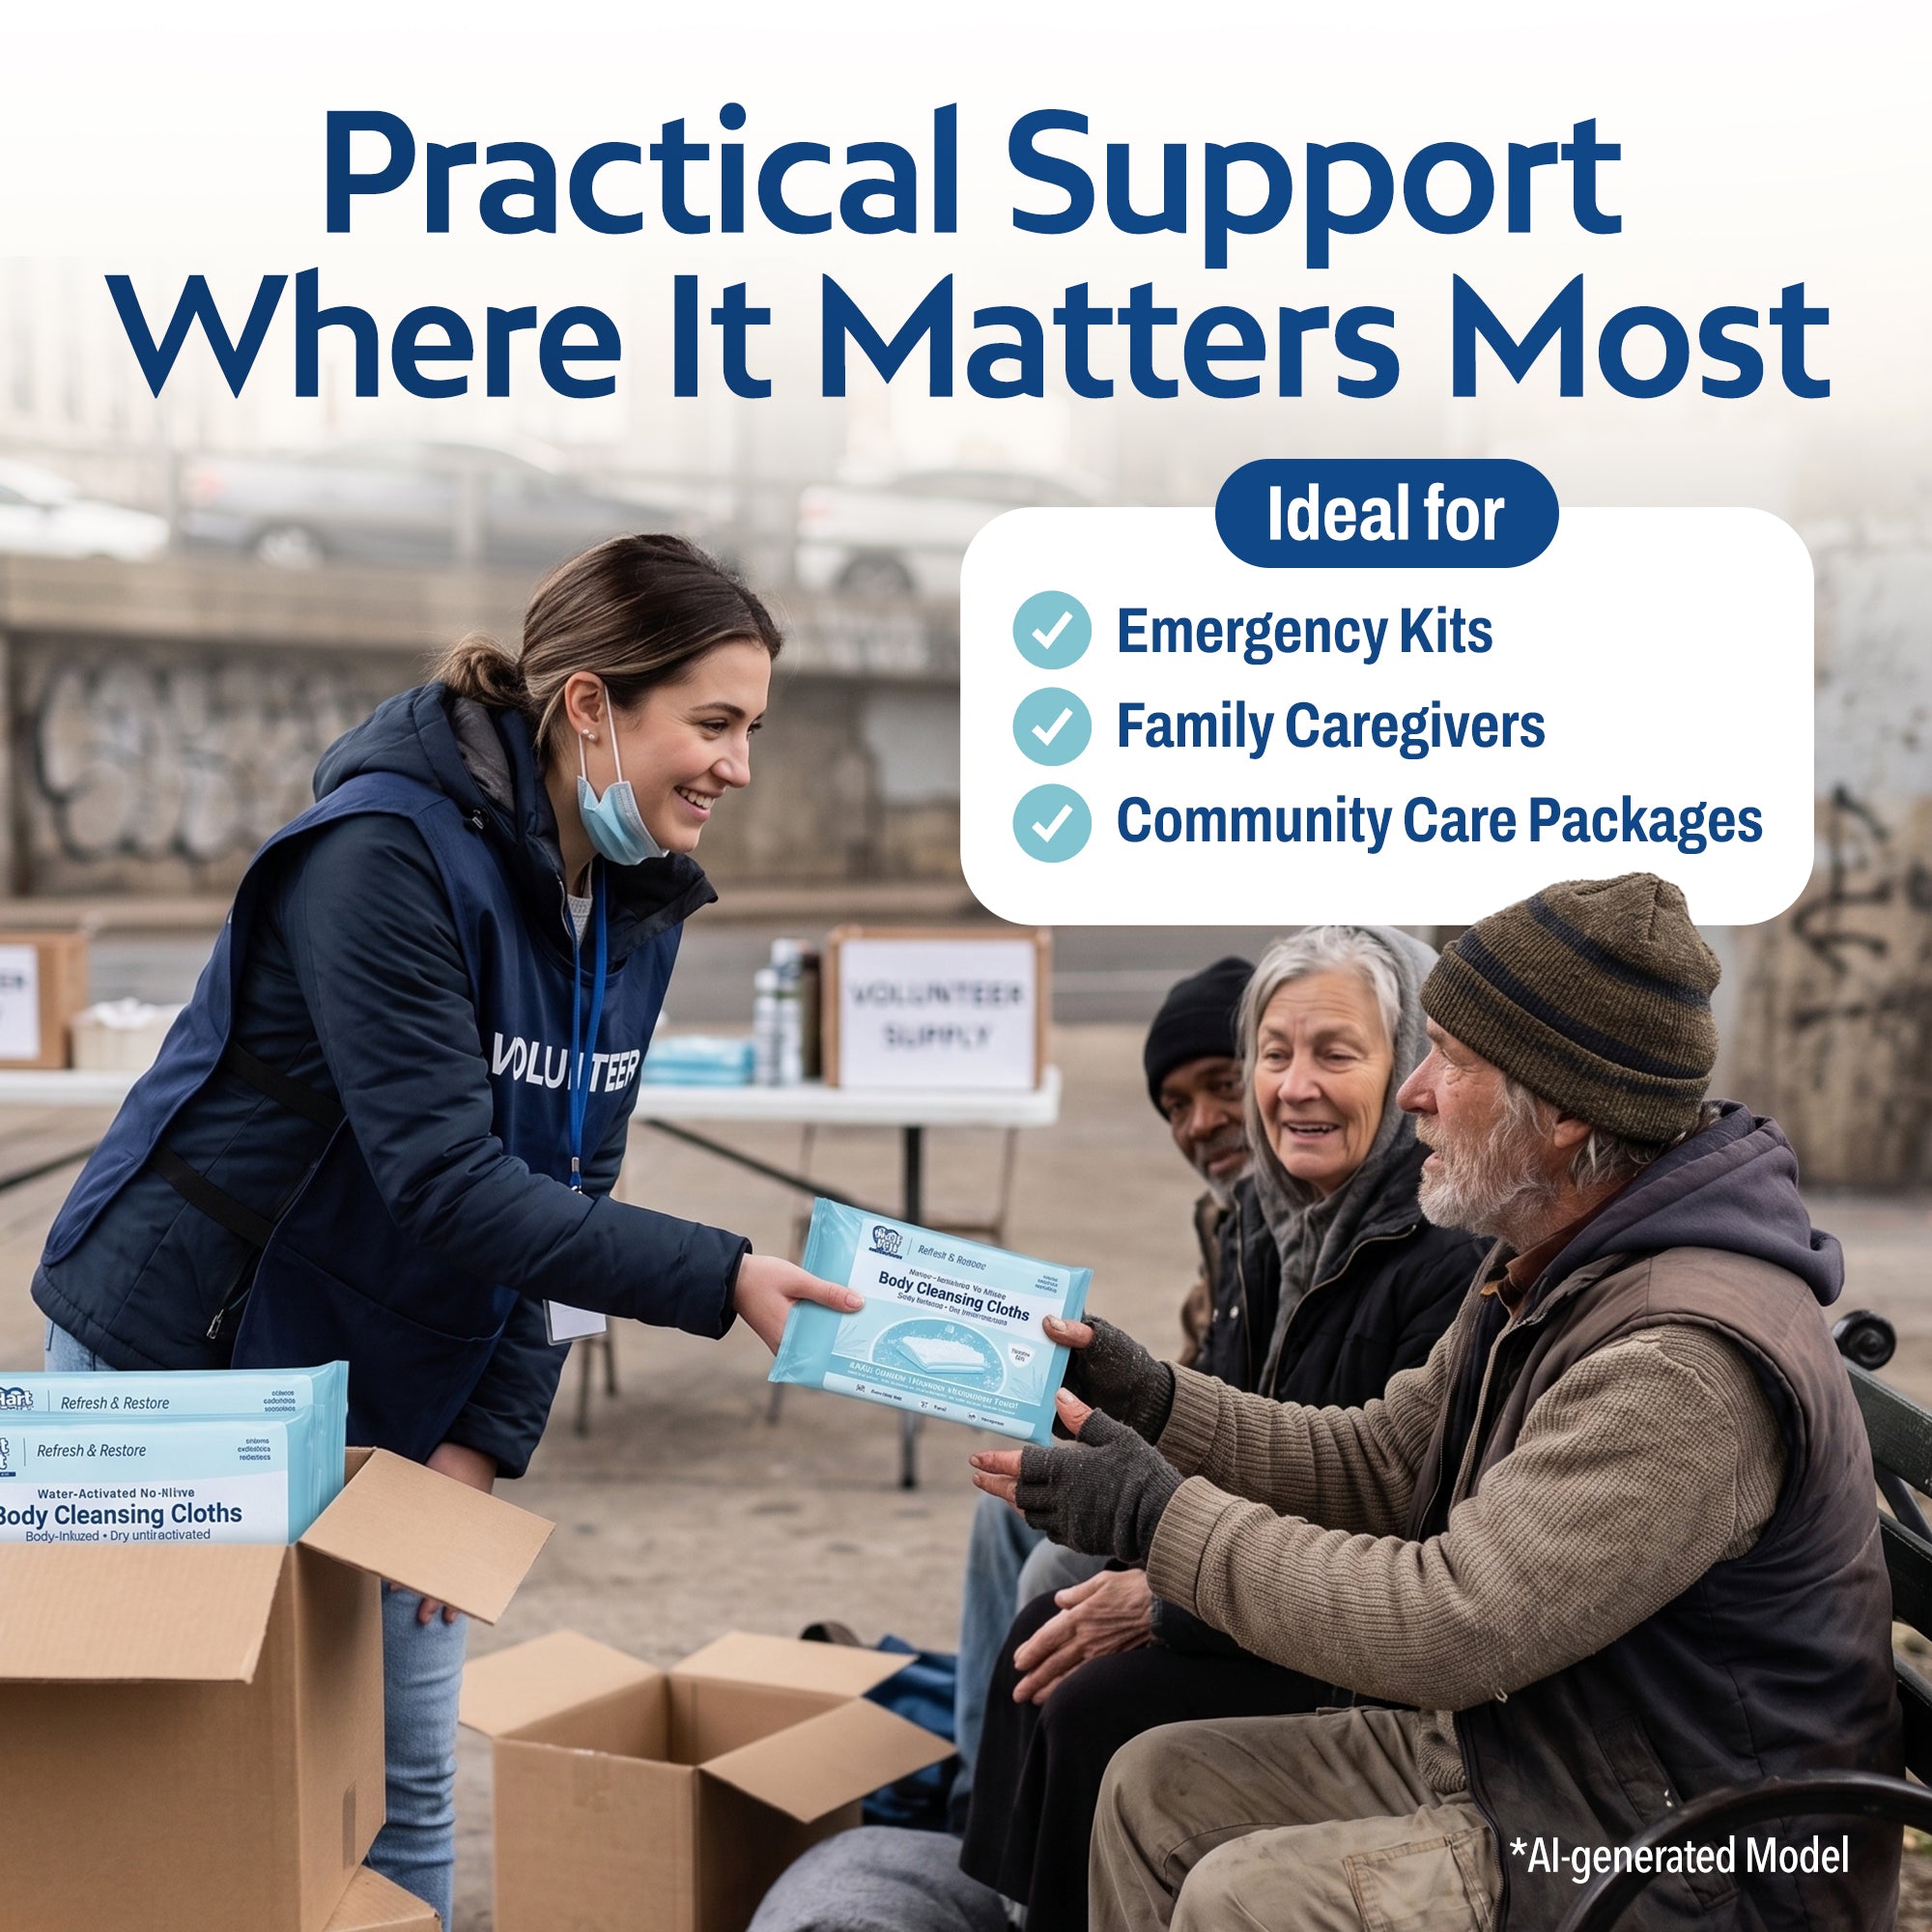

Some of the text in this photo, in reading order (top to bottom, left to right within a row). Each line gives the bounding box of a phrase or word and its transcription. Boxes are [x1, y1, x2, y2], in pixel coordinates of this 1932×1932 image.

[850, 979, 1023, 1007] VOLUNTEER
[884, 1024, 992, 1050] SUPPLY
[878, 1270, 914, 1293] Body
[917, 1281, 983, 1313] Cleansing
[986, 1299, 1030, 1321] Cloths
[61, 1396, 170, 1409] Refresh & Restore
[37, 1444, 147, 1458] Refresh & Restore
[38, 1488, 136, 1499] Water-Activated
[54, 1503, 164, 1529] Cleansing
[171, 1502, 242, 1523] Cloths
[110, 1530, 129, 1544] Dry
